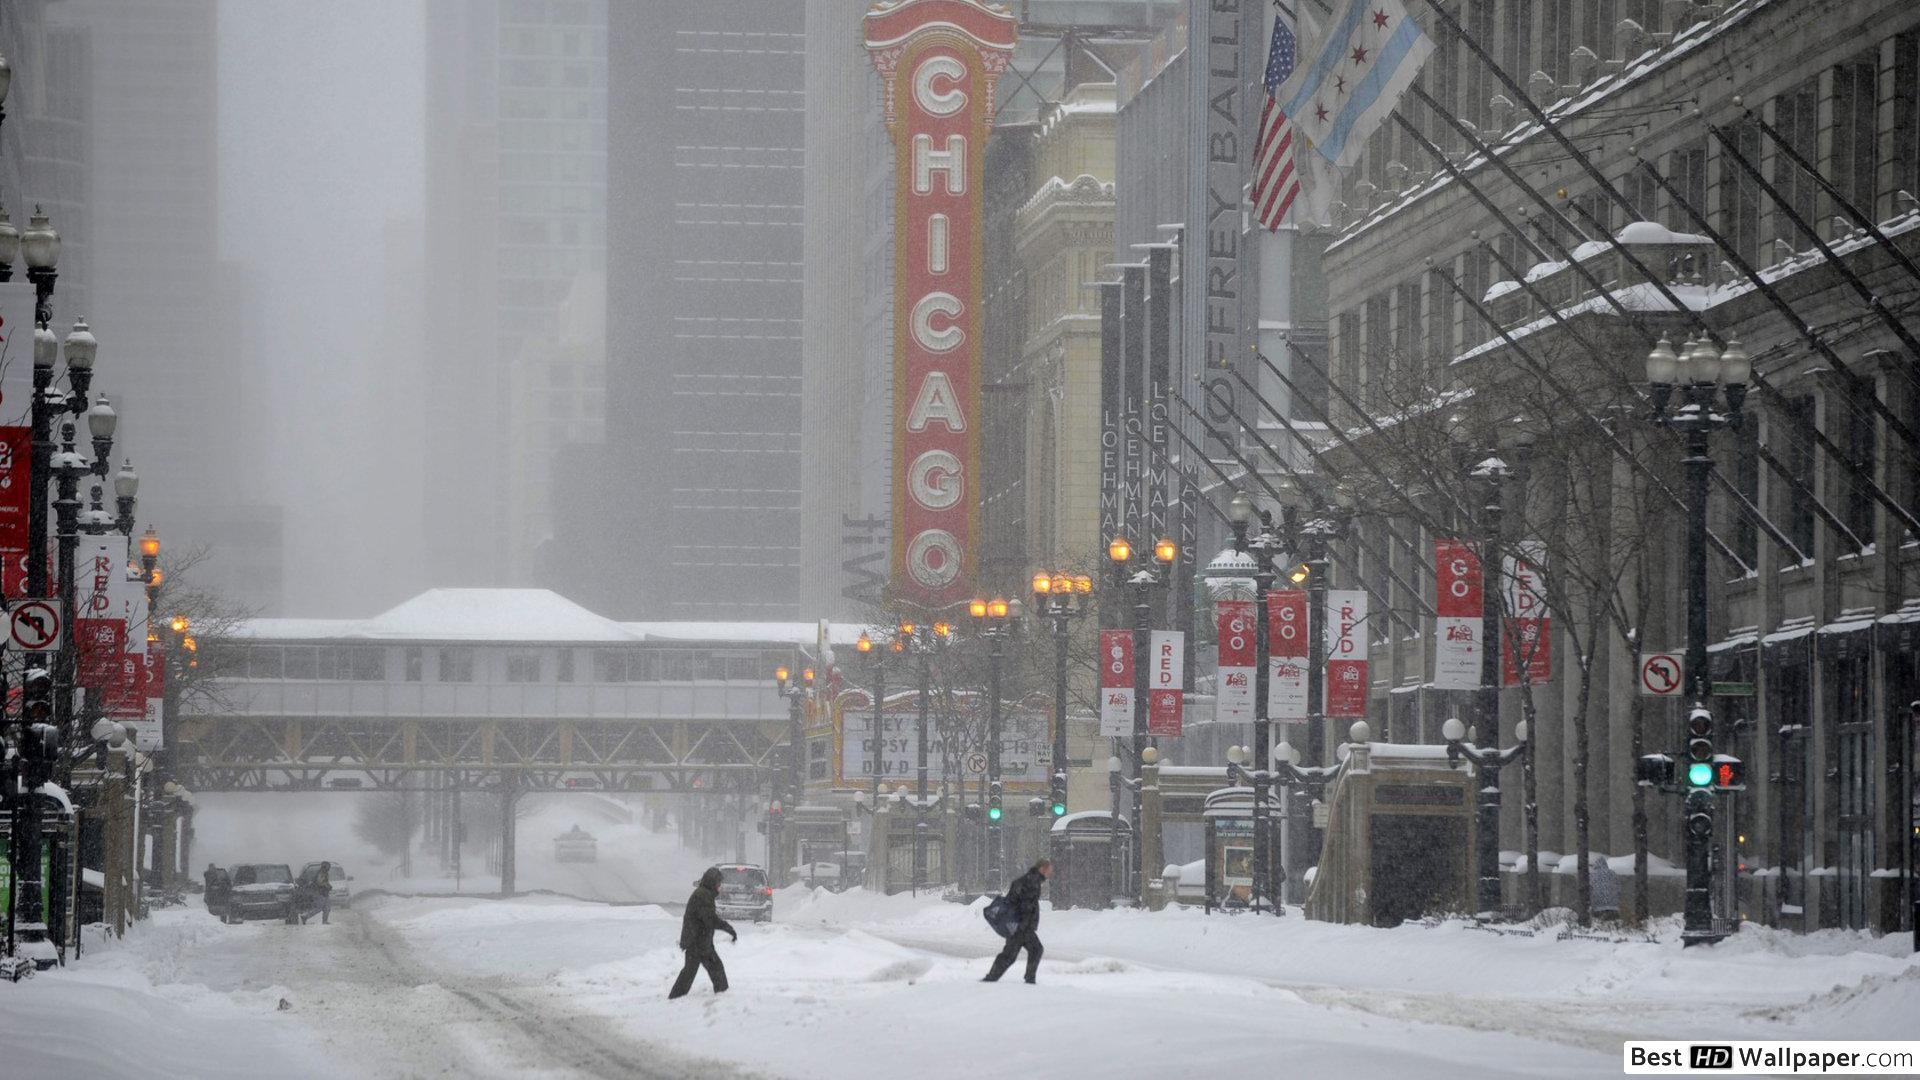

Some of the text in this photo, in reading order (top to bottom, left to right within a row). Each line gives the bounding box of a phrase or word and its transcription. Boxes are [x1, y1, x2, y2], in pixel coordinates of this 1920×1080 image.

[906, 55, 968, 589] CHICAGO
[93, 555, 110, 611] RED
[1450, 559, 1468, 598] GO
[1230, 619, 1245, 650] GO
[1280, 606, 1296, 640] GO
[1341, 606, 1354, 654] RED
[1160, 644, 1172, 684] RED
[862, 738, 908, 753] GPSY
